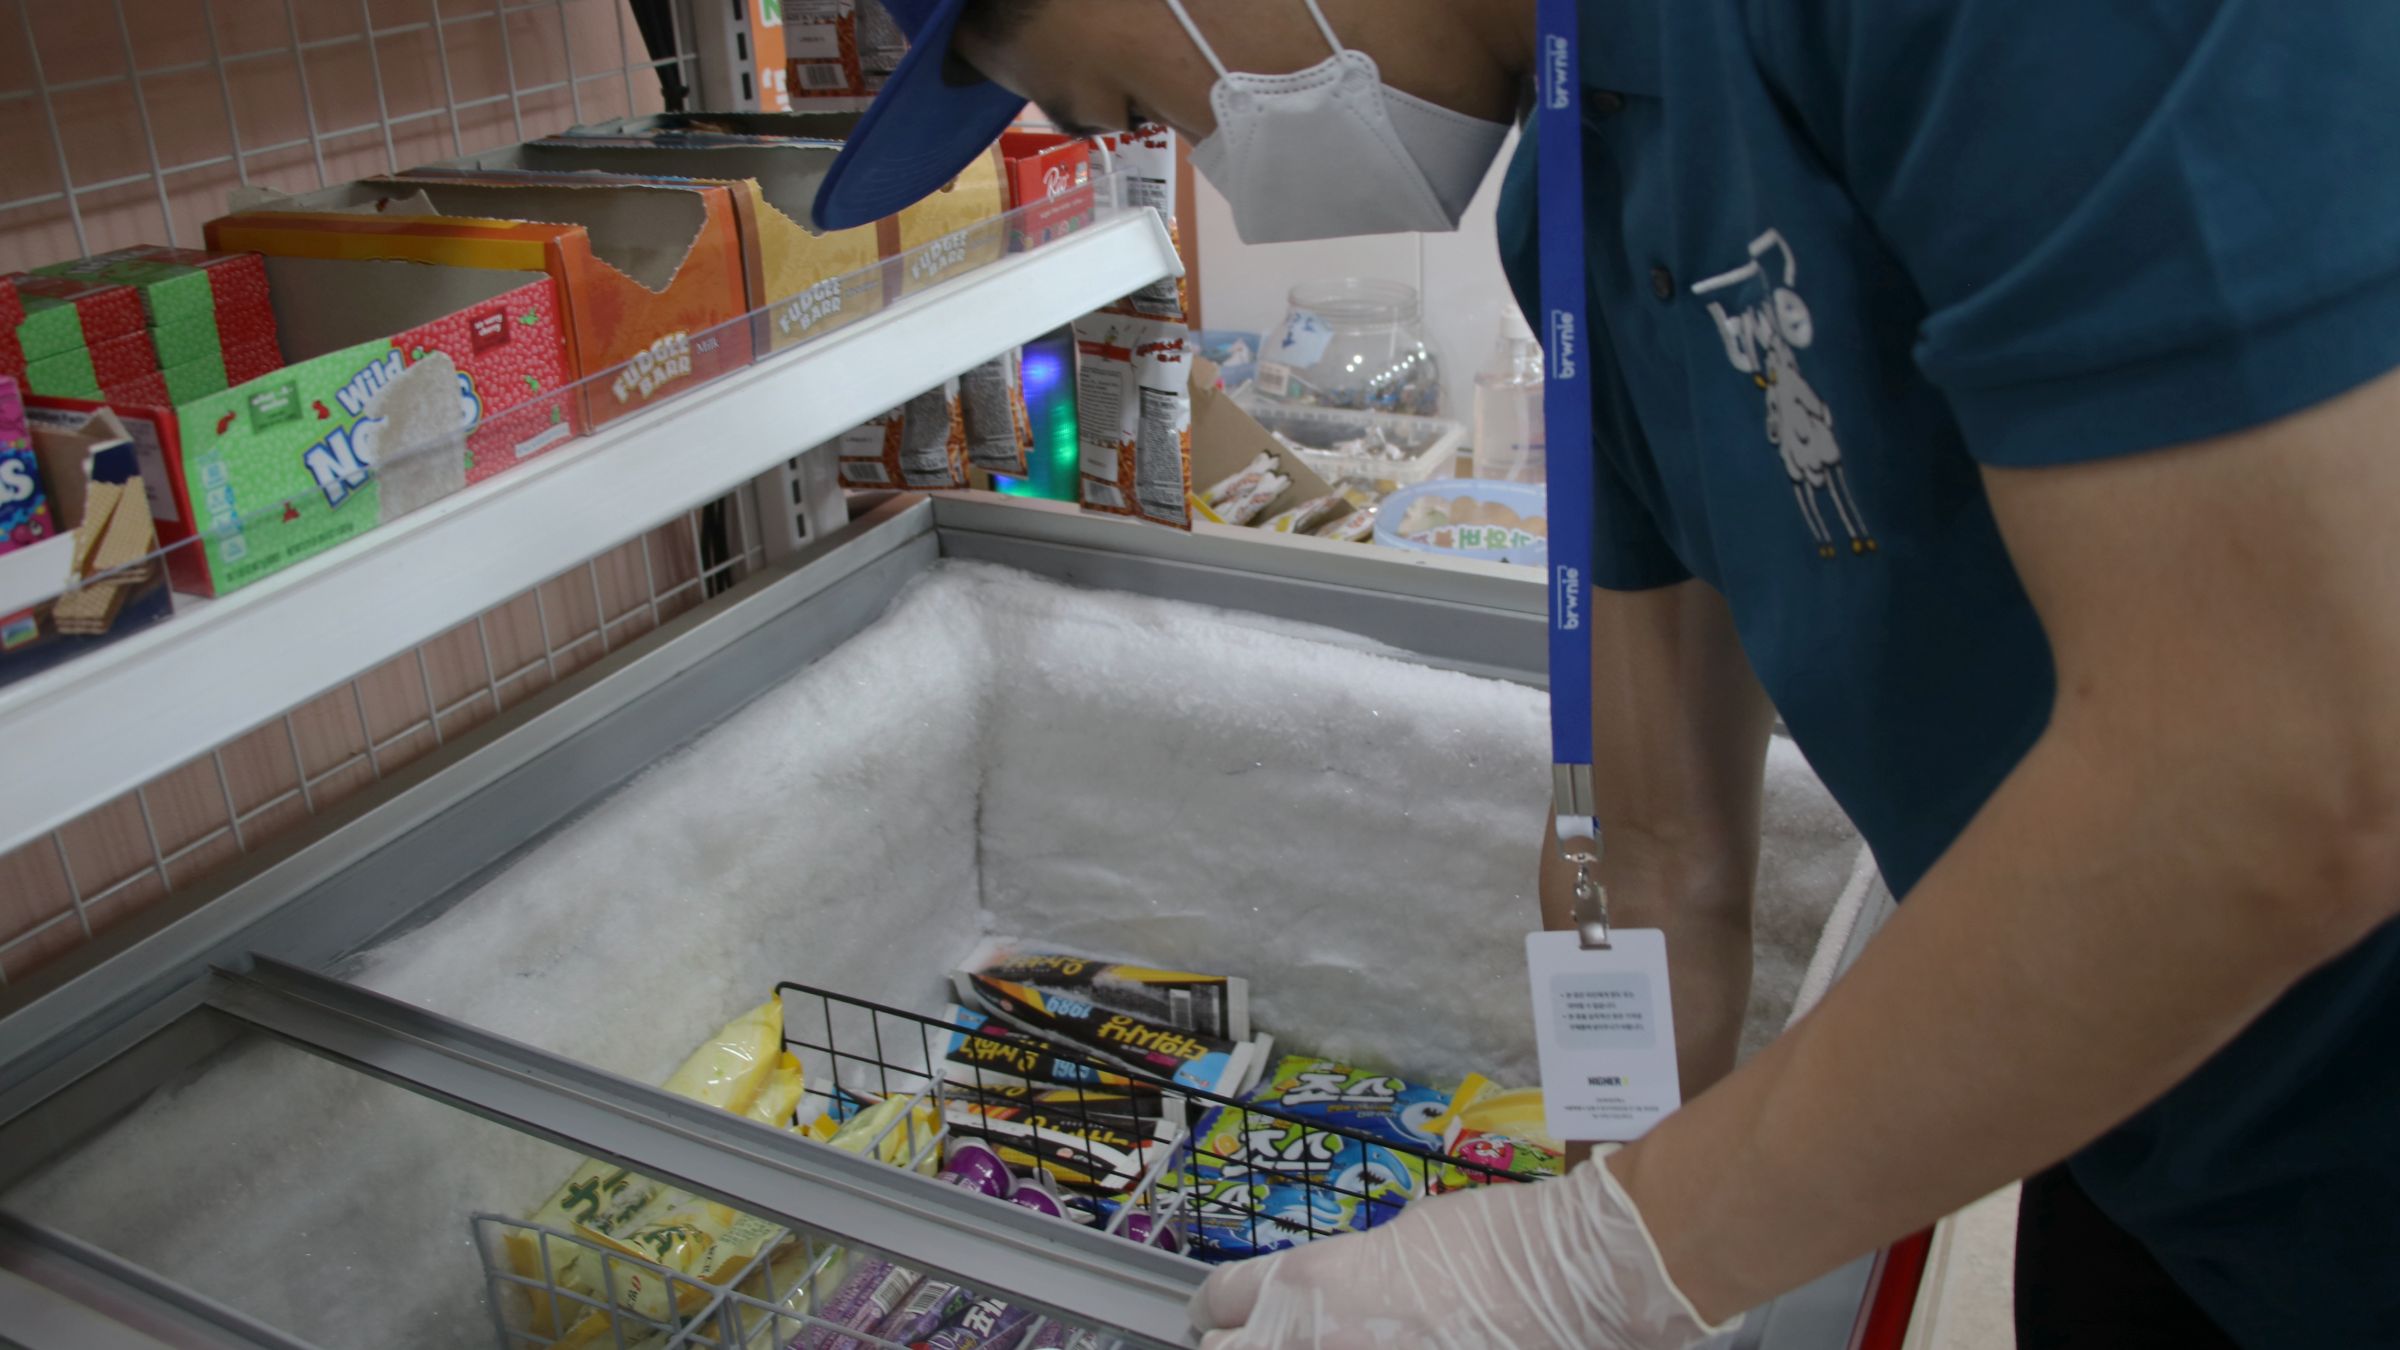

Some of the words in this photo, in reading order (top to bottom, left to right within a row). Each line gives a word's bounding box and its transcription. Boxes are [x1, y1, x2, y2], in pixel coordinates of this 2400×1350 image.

[778, 276, 841, 335] FUDGEE
[801, 296, 841, 331] BARR
[612, 330, 690, 404] FUDGEE
[696, 337, 720, 354] Milk
[336, 348, 407, 417] Wild
[639, 355, 692, 399] BARR
